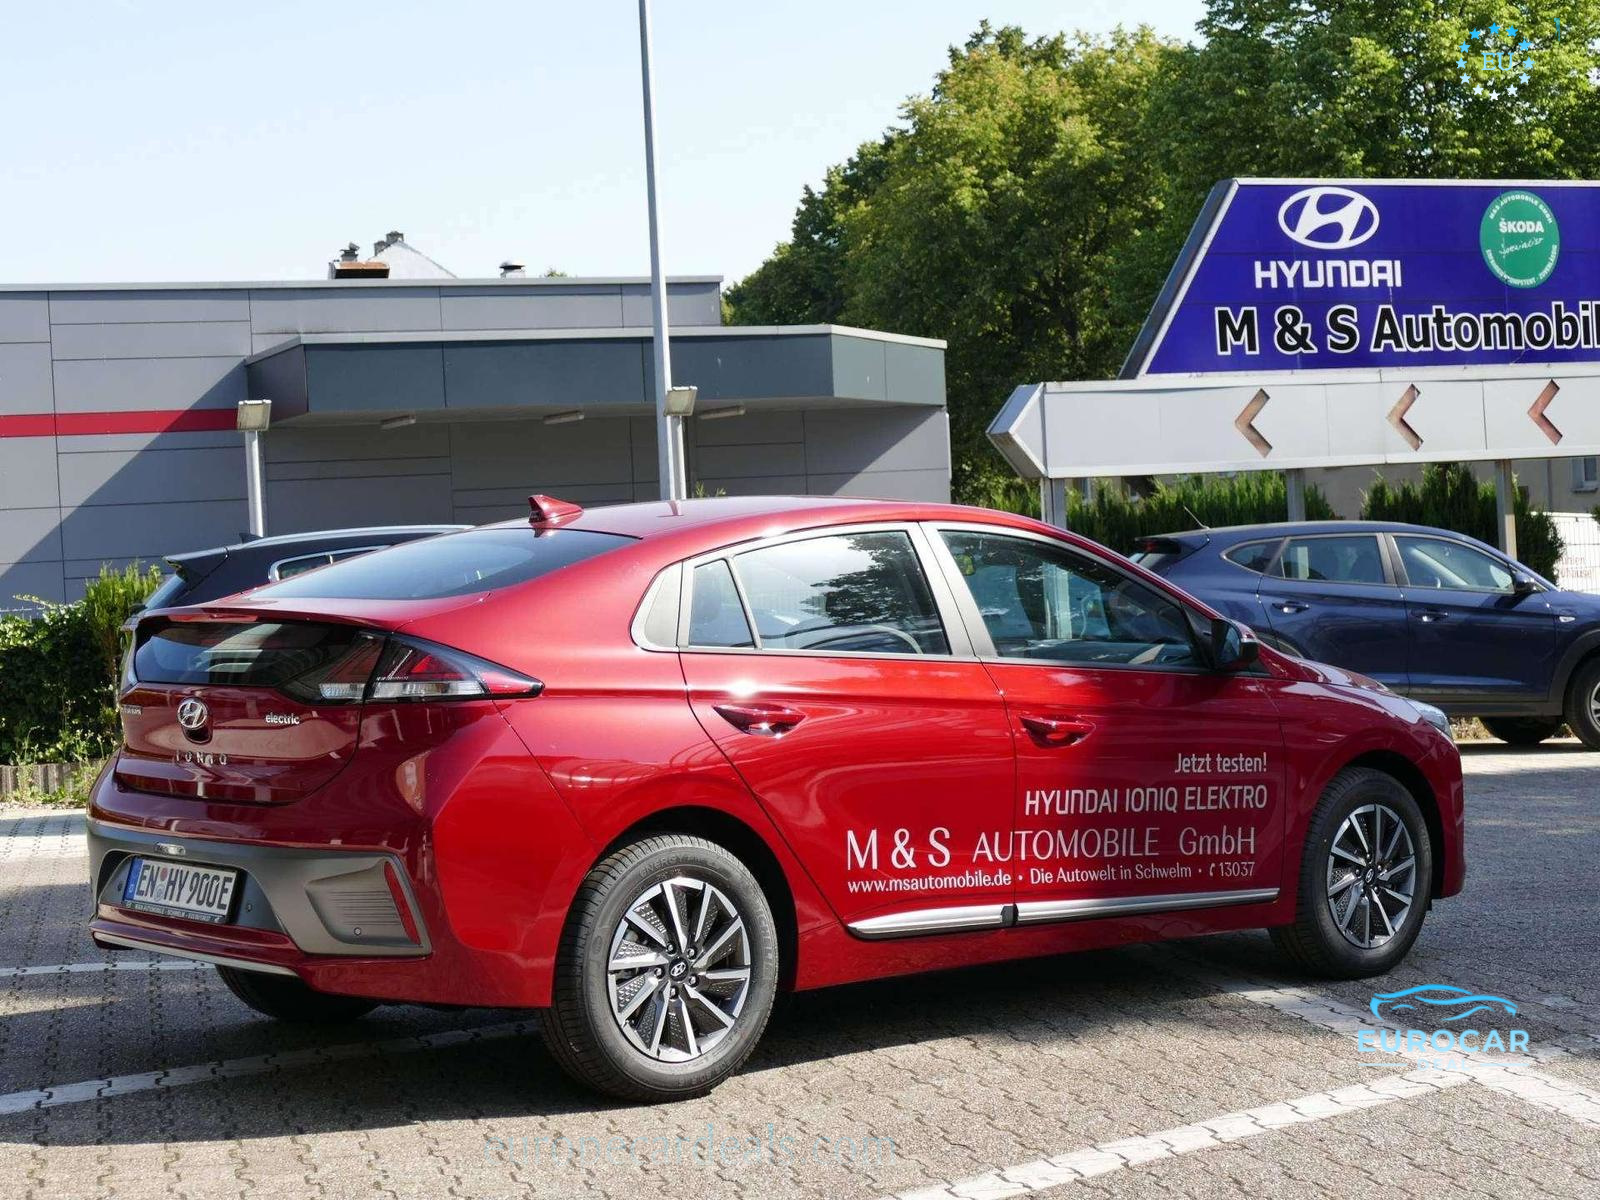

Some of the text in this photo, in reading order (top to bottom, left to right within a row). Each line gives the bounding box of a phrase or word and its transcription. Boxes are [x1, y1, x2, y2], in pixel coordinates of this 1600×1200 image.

[1499, 217, 1544, 233] ŠKODA
[1254, 260, 1402, 288] HYUNDAI
[1215, 306, 1259, 356] M
[1274, 305, 1318, 354] &
[1327, 304, 1360, 352] S
[266, 712, 300, 724] electric
[1175, 752, 1267, 773] Jetzt testen!
[1025, 785, 1268, 815] HYUNDAI IONIQ ELEKTRO
[847, 825, 1256, 870] M & S AUTOMOBILE GmbH
[136, 864, 233, 910] EN HY 900E
[847, 862, 1255, 893] www.msautomobile.de Die Autowelt in Schwelm 13037
